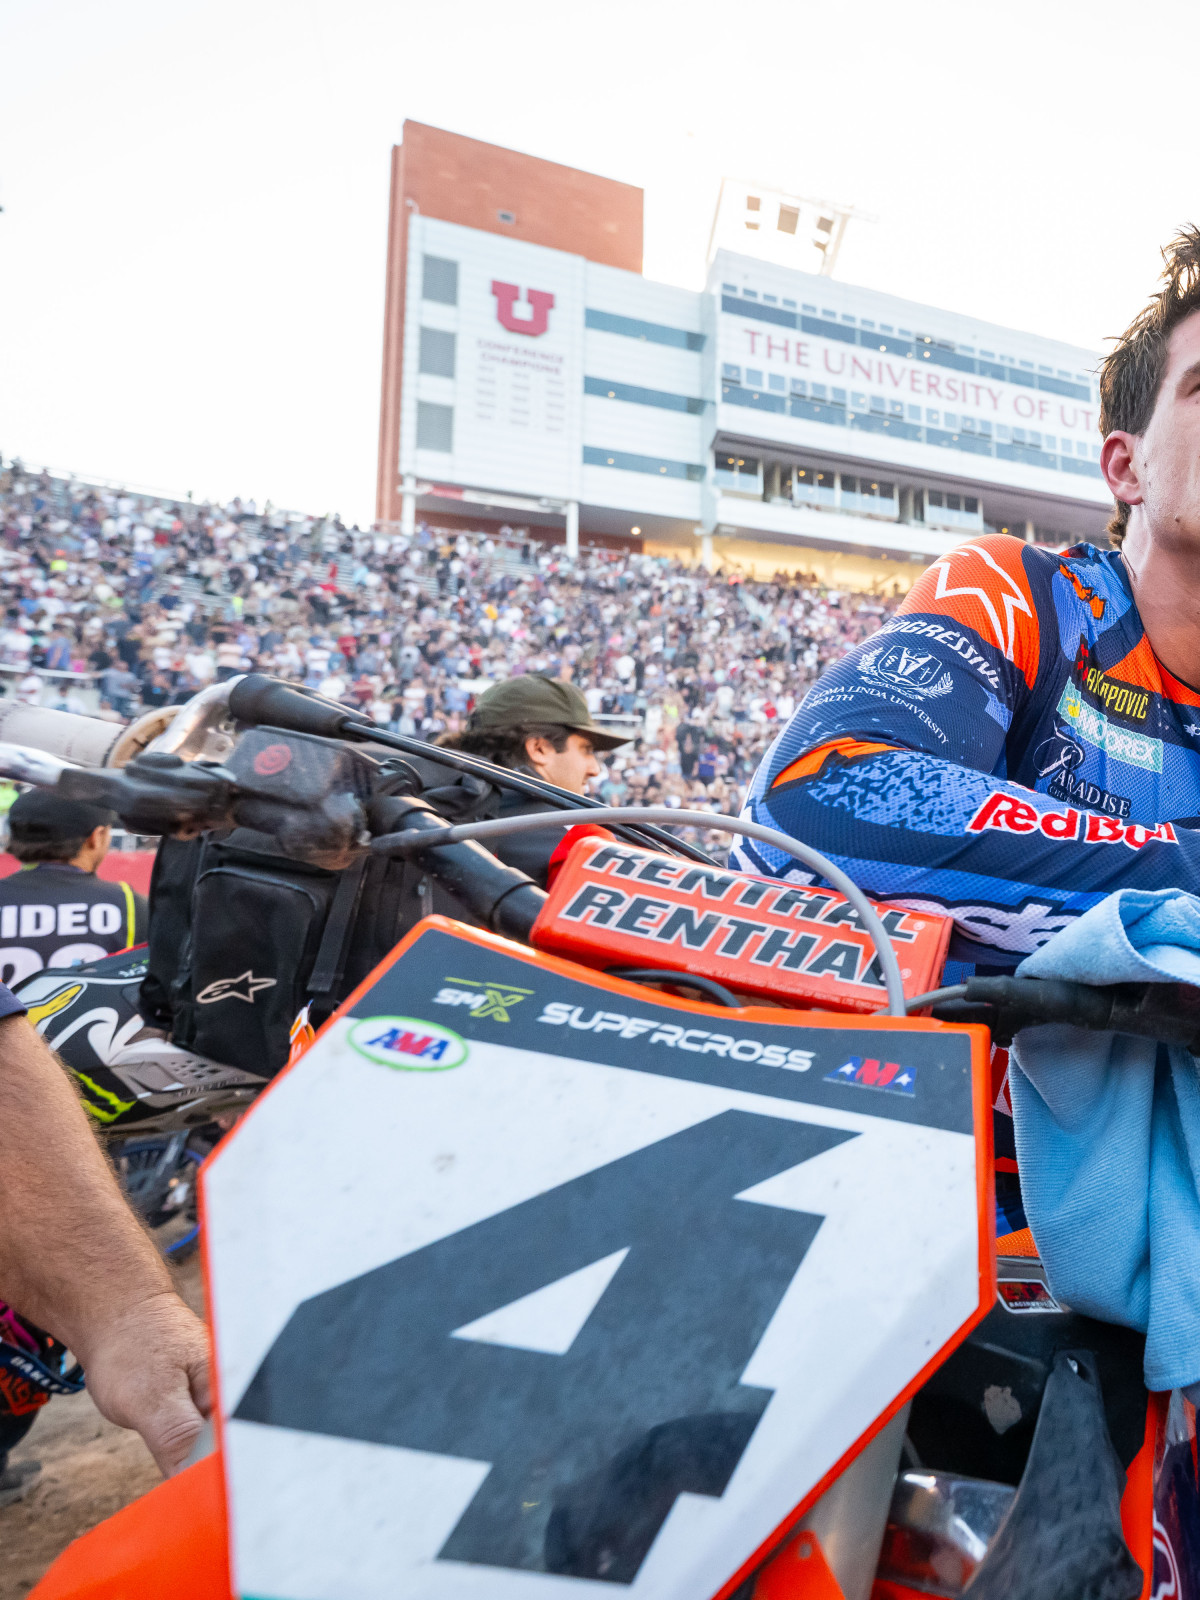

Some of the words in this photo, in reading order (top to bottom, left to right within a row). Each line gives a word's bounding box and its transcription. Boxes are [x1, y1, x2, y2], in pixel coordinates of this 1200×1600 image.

[491, 279, 555, 337] U
[744, 328, 811, 369] THE
[822, 347, 1004, 412] UNIVERSITY
[1013, 393, 1050, 422] OF
[1059, 404, 1102, 433] UT
[874, 618, 1002, 690] OGRESSIVE
[813, 686, 846, 701] LOMA
[847, 684, 888, 701] LINDA
[889, 694, 950, 745] UNIVERSITY
[965, 790, 1081, 842] Red
[0, 902, 123, 939] IDEO
[582, 844, 918, 945] RENTHAL
[365, 1027, 450, 1062] AMA
[432, 987, 526, 1023] SMX
[535, 1001, 817, 1073] SUPERCROSS
[828, 1055, 918, 1094] AMA
[228, 1108, 867, 1587] 4
